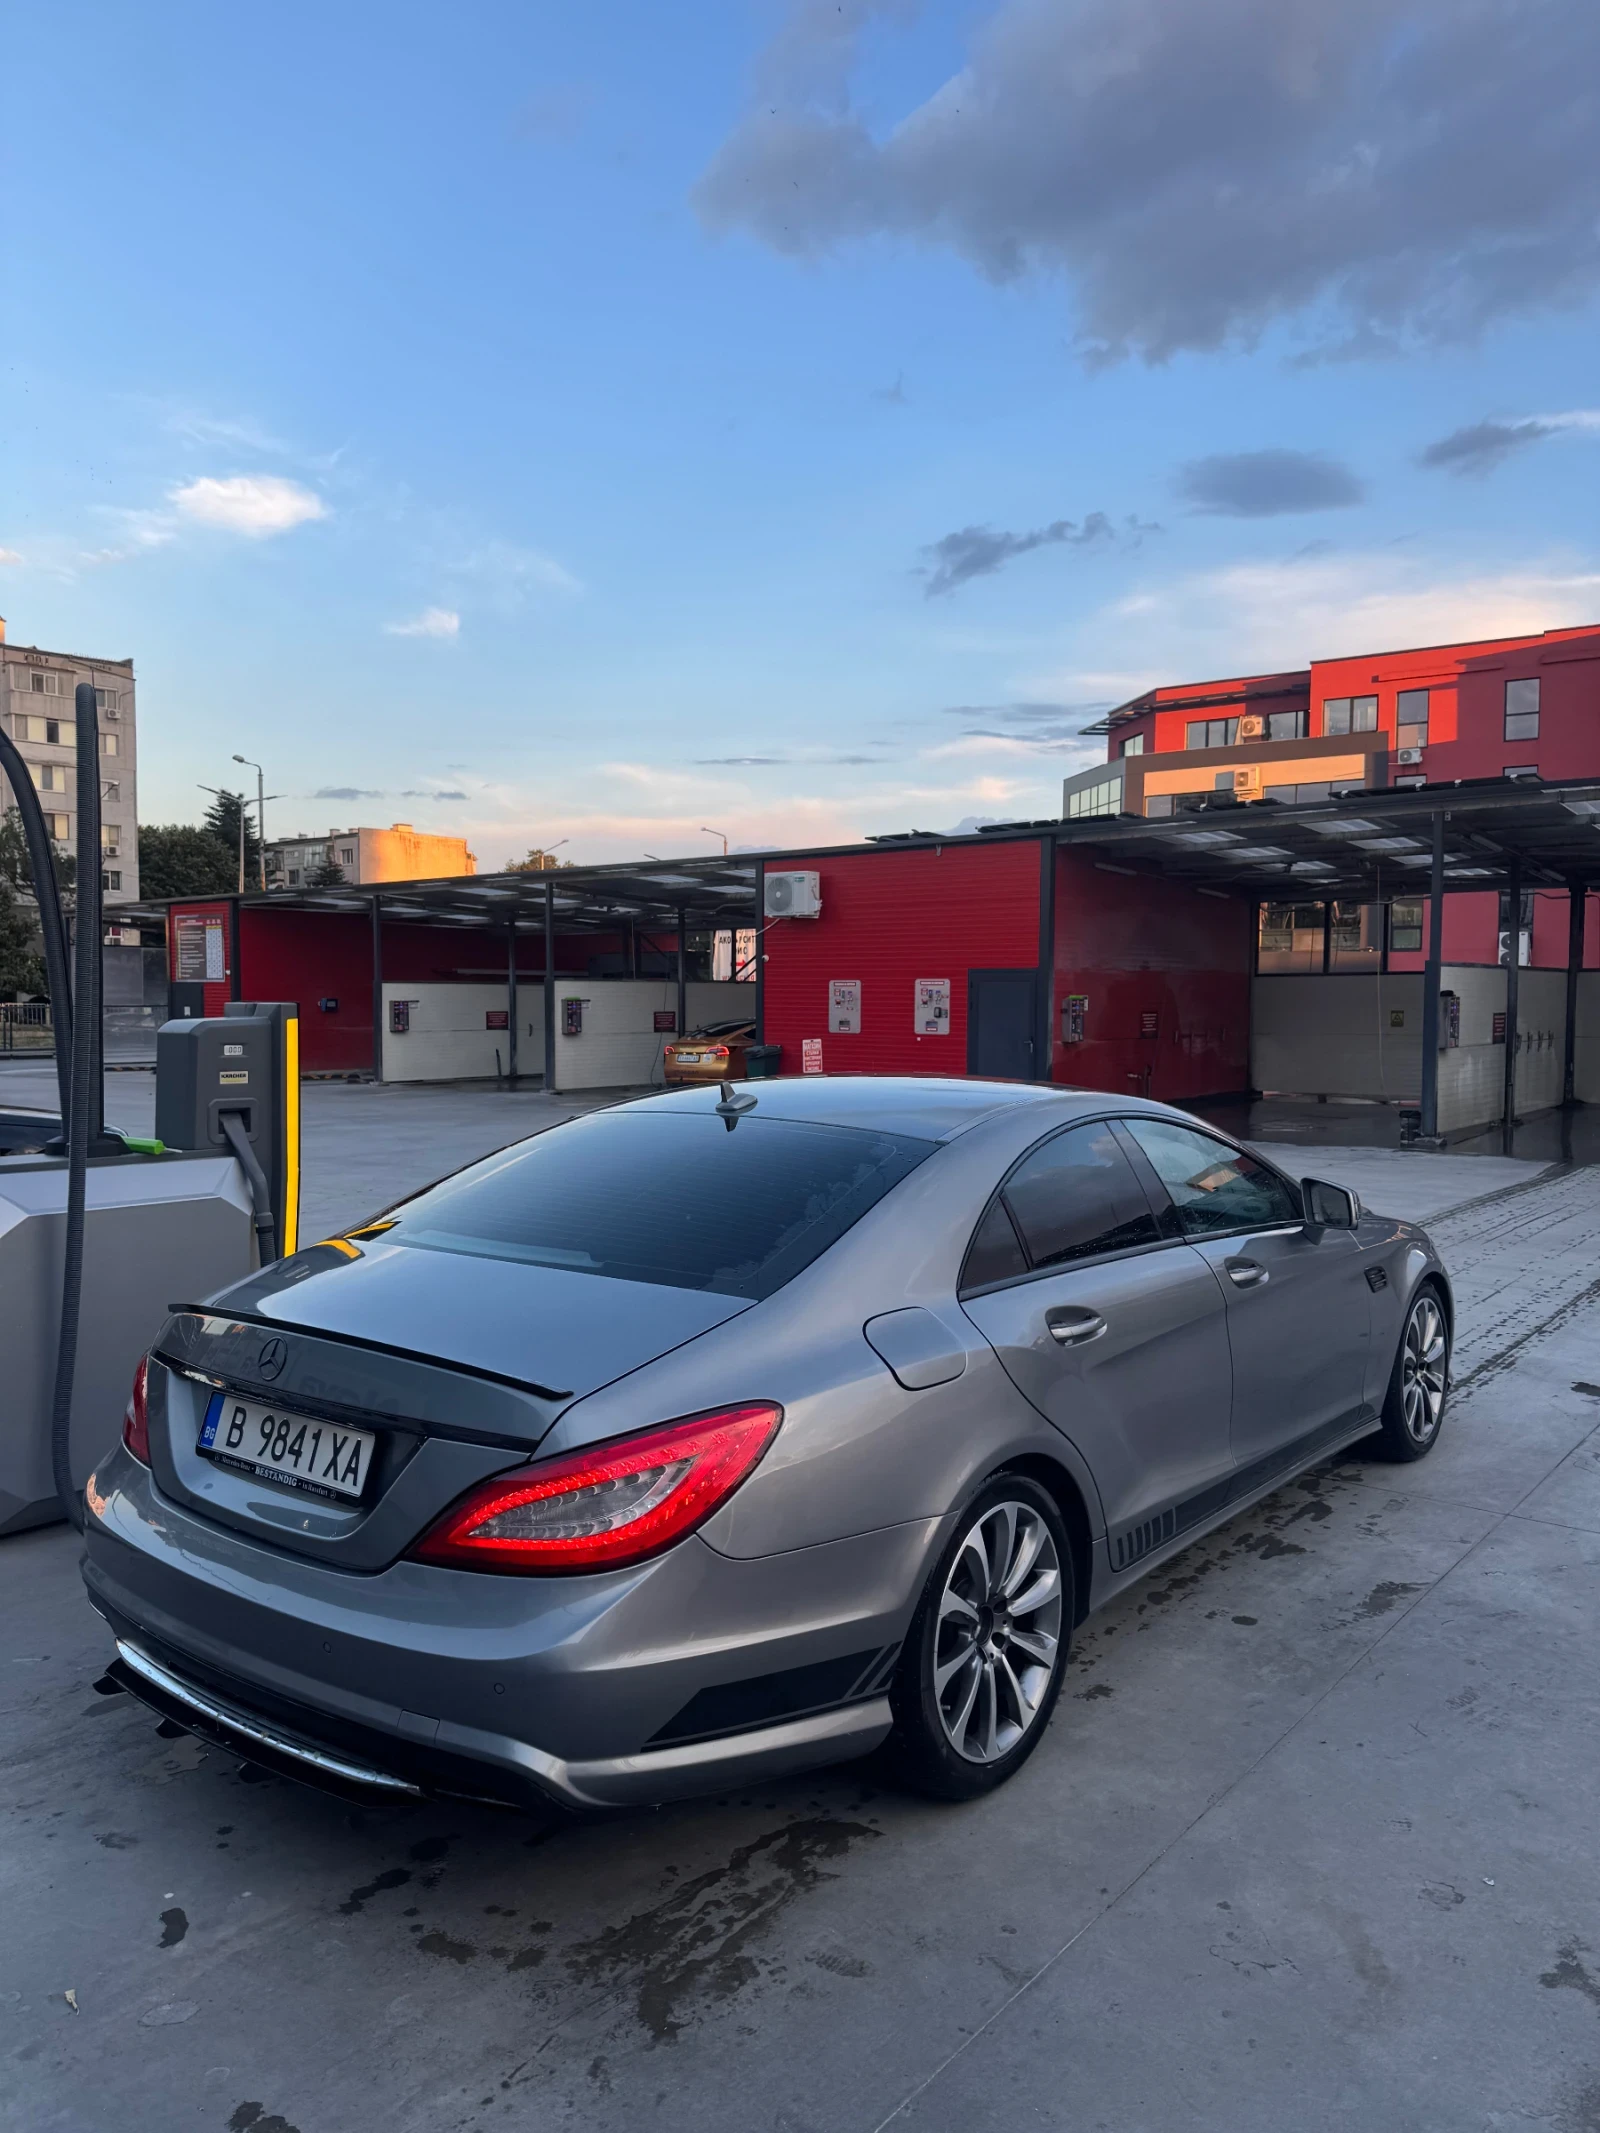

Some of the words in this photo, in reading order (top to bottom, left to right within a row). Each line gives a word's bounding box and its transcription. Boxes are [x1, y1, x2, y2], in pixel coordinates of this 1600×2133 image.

[204, 1425, 216, 1440] BG
[226, 1406, 247, 1449] B
[257, 1414, 322, 1473] 9841
[322, 1432, 363, 1487] XA
